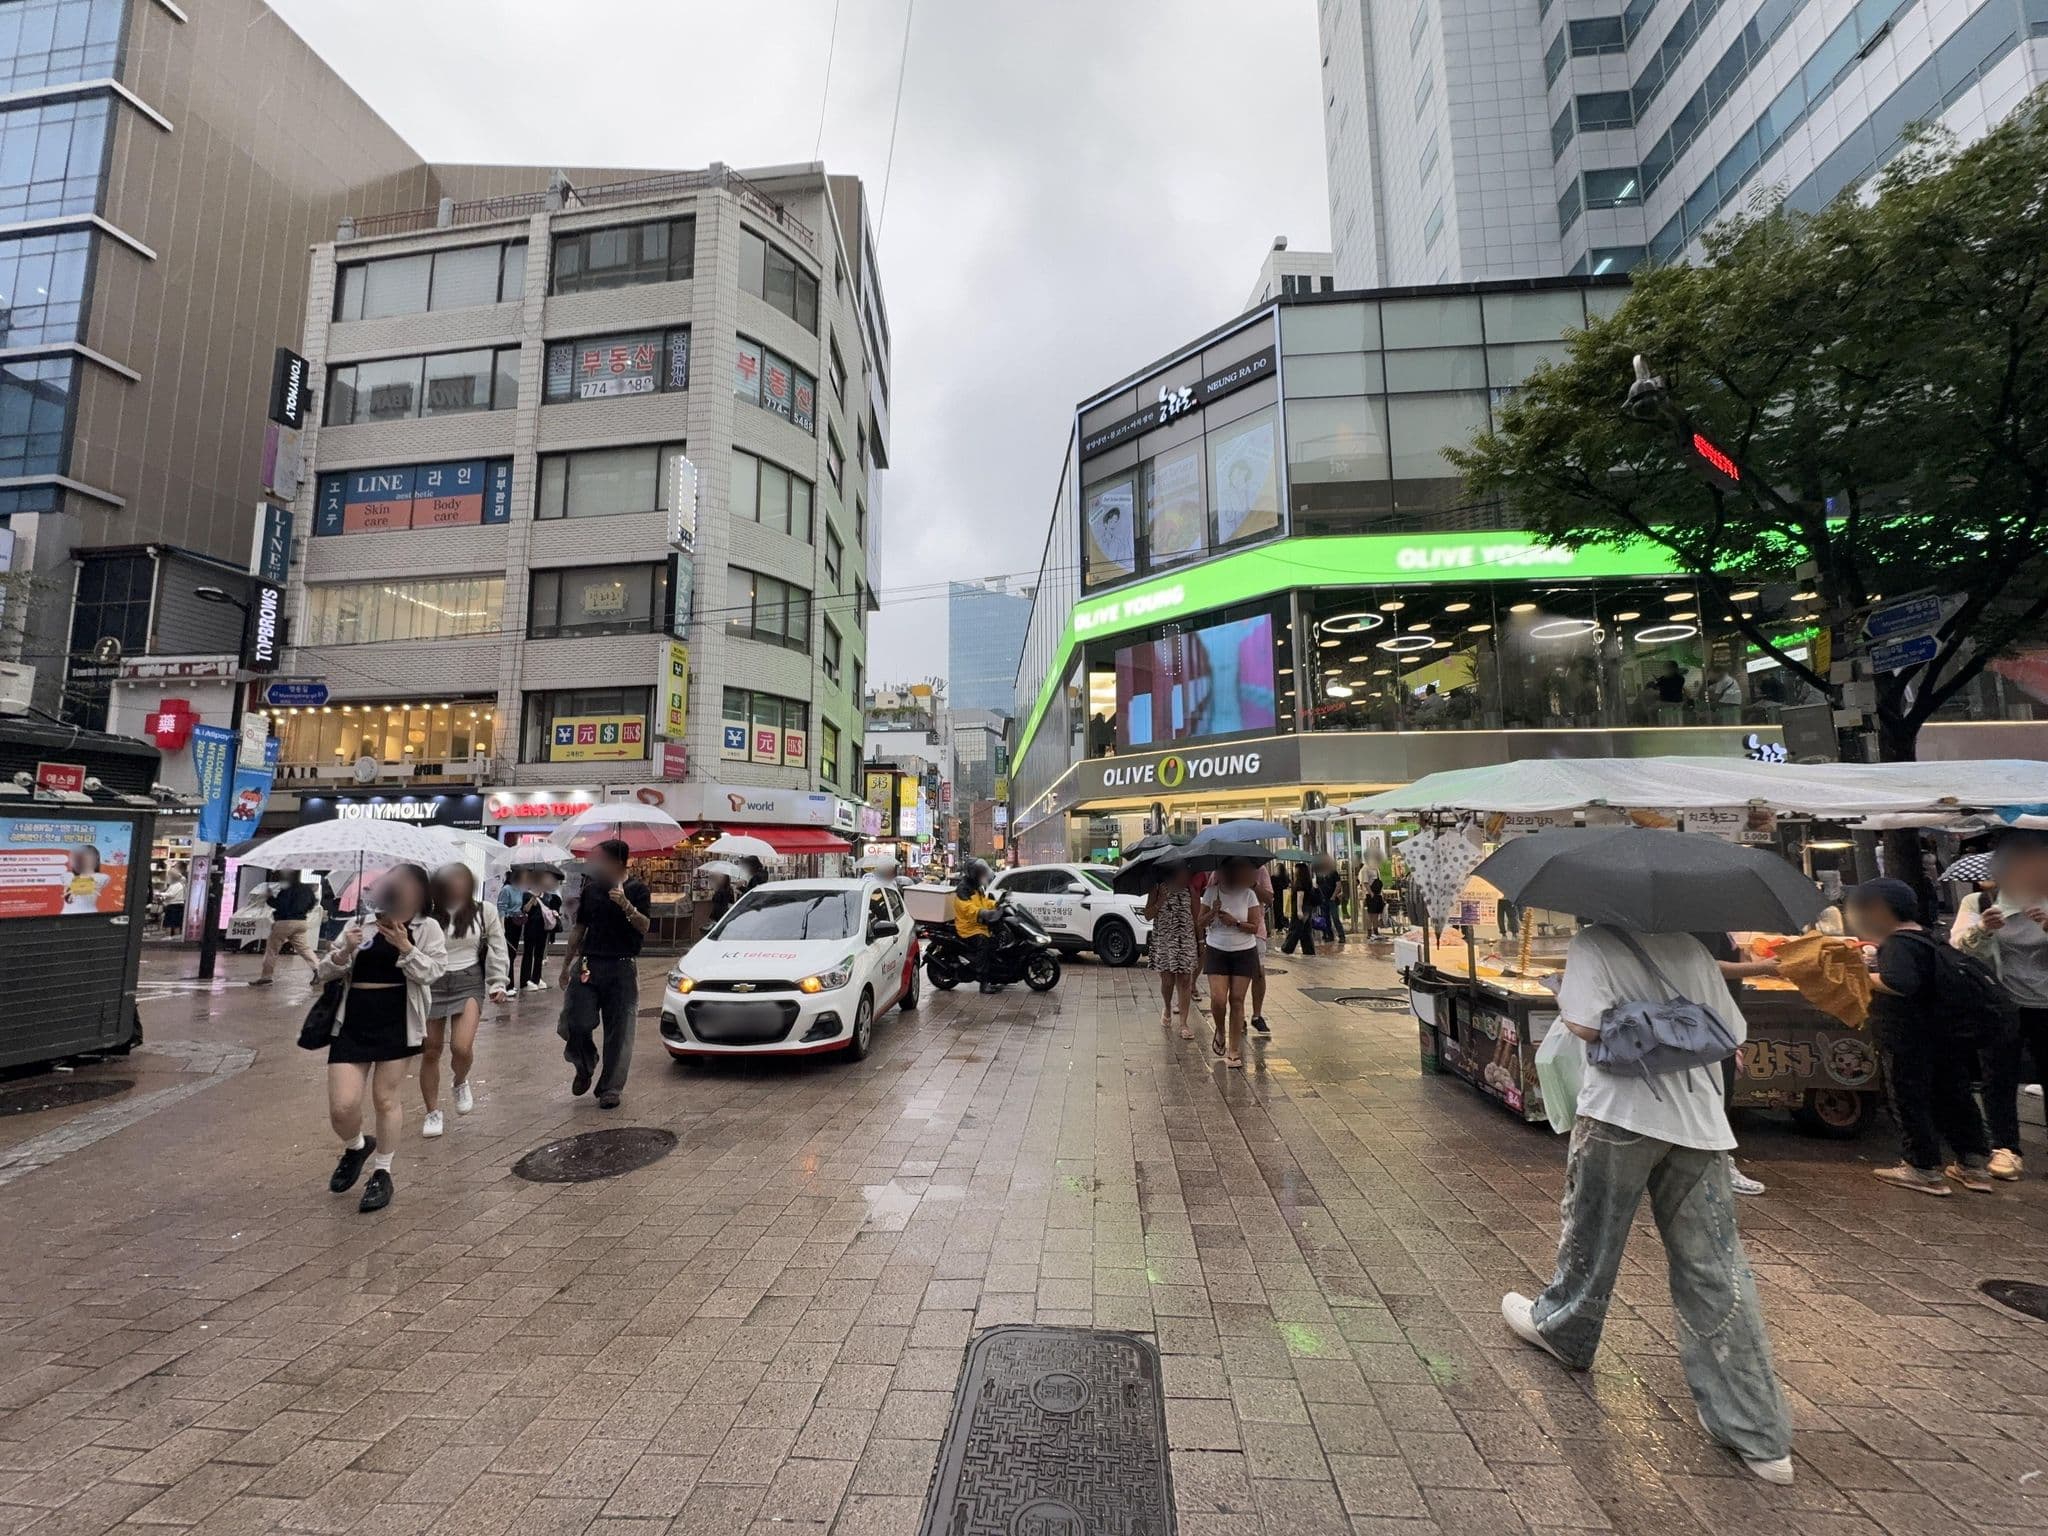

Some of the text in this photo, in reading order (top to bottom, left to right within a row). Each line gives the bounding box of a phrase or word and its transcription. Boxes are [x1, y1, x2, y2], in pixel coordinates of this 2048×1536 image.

[582, 343, 656, 377] 부동산
[736, 351, 814, 414] 부동산
[1207, 358, 1267, 394] NEUNG RA DO
[285, 359, 302, 421] TONYMOLY
[357, 474, 403, 493] LINE
[494, 466, 507, 517] 피부관리
[326, 482, 341, 527] エステ
[364, 504, 390, 516] Skin
[433, 499, 461, 511] Body
[364, 516, 389, 527] care
[434, 512, 459, 522] care
[270, 509, 286, 566] LINE
[1397, 544, 1574, 569] OLIVE YOUNG
[1074, 584, 1185, 632] OLIVE YOUNG
[256, 588, 278, 662] TOPBROWS
[158, 714, 176, 733] 藥
[623, 723, 641, 741] HK$
[580, 727, 595, 742] 元
[603, 724, 615, 743] $
[760, 735, 773, 750] 元
[787, 739, 802, 755] HK$
[212, 744, 227, 799] WELCOME TO
[1103, 765, 1154, 787] OLIVE
[1187, 753, 1261, 779] YOUNG
[335, 802, 440, 820] TONYMOLY
[747, 801, 774, 812] world
[231, 927, 257, 936] SHEET
[233, 920, 257, 928] MASK
[722, 951, 798, 960] kt telecop
